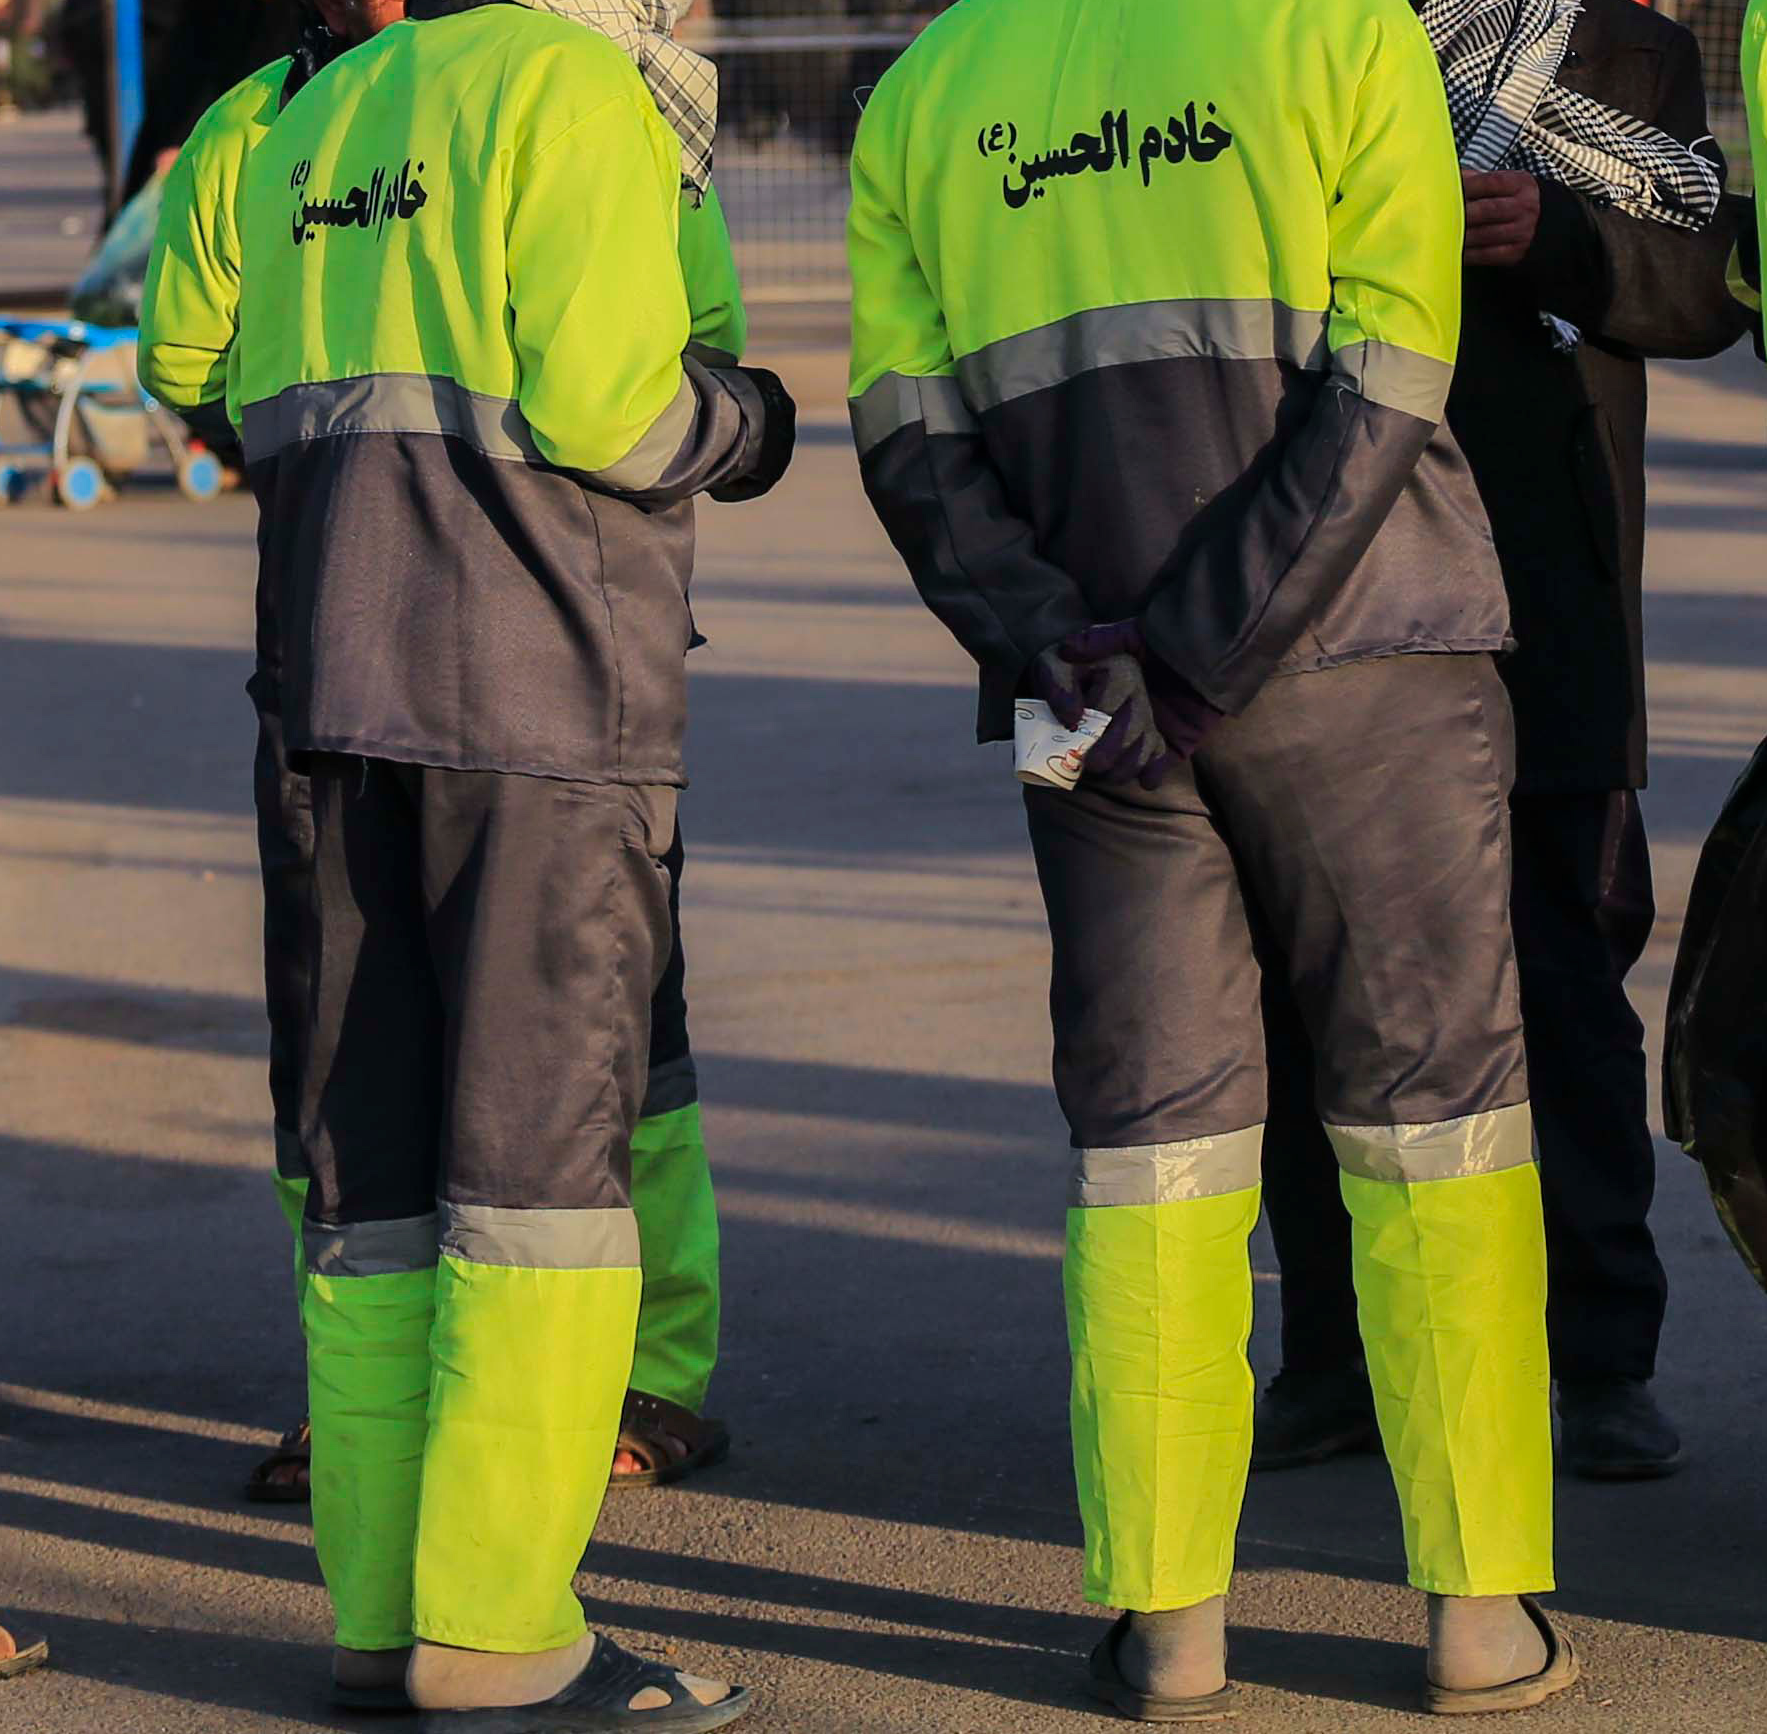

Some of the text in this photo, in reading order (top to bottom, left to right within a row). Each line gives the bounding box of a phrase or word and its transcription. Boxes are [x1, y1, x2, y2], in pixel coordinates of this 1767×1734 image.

[1002, 108, 1130, 209] الحسين
[1139, 100, 1233, 188] خادم
[292, 166, 386, 246] الحسين
[376, 158, 428, 243] خادم
